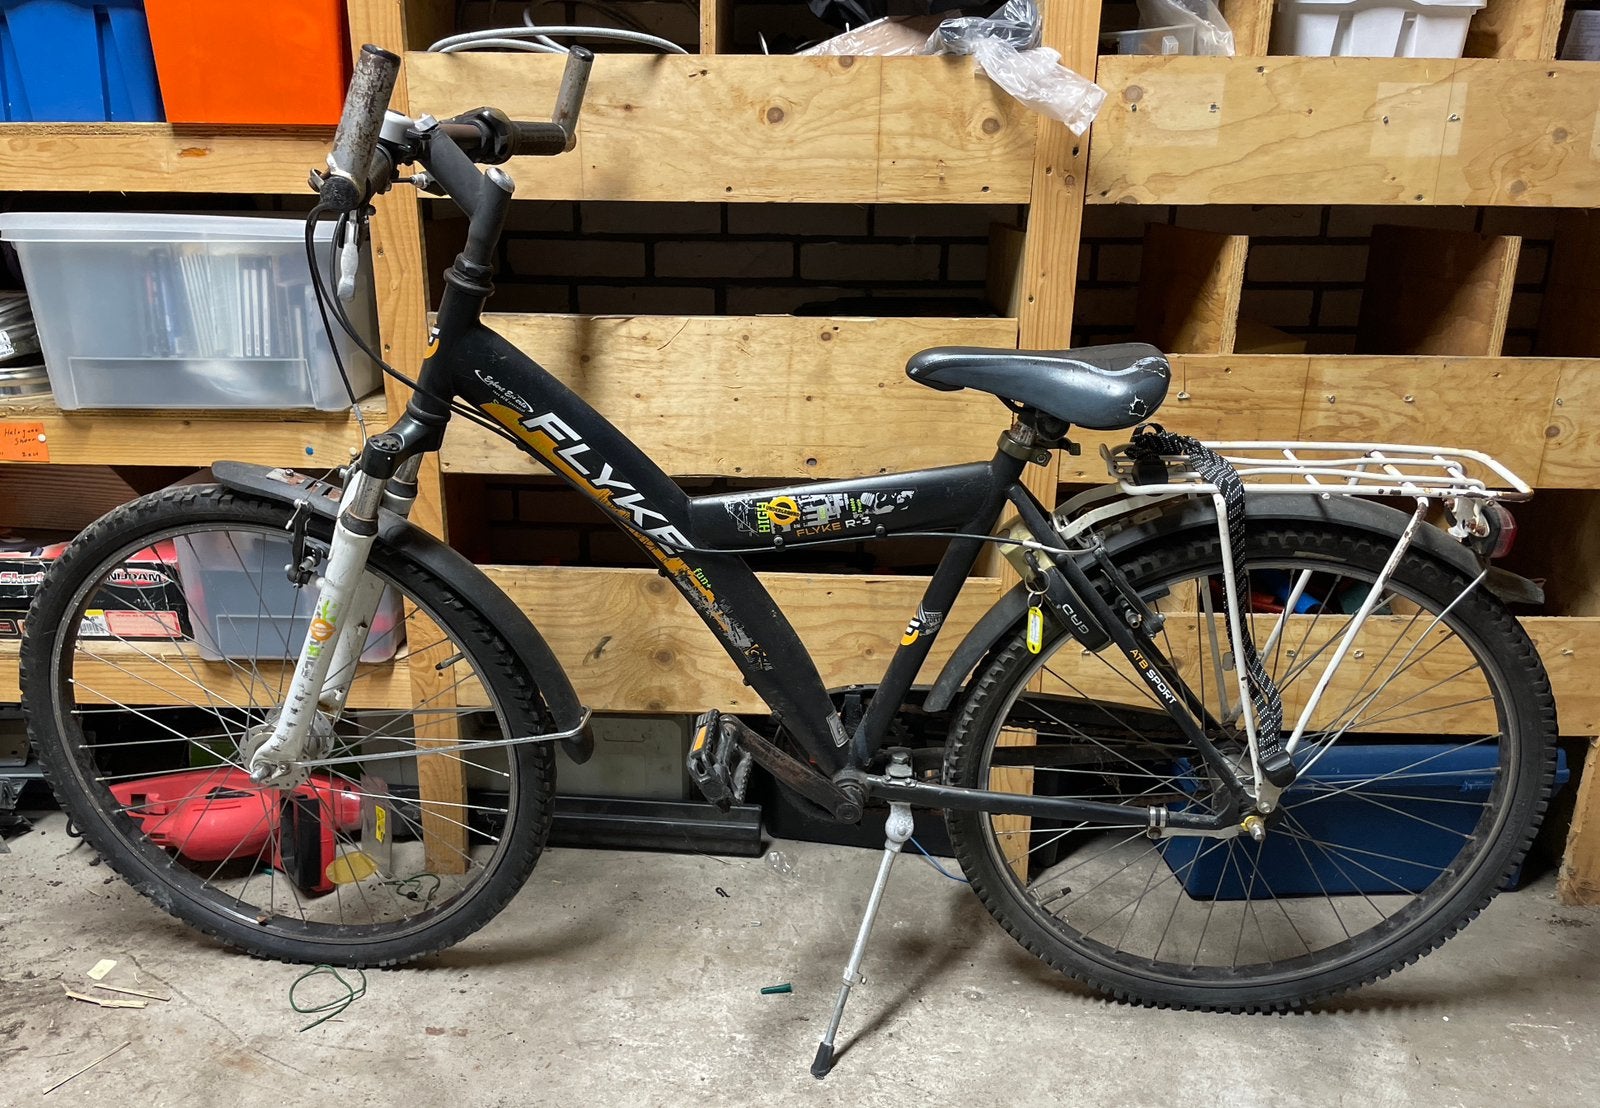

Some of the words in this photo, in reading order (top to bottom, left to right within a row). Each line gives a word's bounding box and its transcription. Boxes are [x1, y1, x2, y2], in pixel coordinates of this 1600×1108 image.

[522, 412, 697, 556] FLYKE
[756, 502, 771, 533] HIGH
[796, 522, 841, 537] FLYKE
[845, 516, 872, 528] R-3
[1130, 649, 1149, 670] ATB
[1146, 669, 1177, 704] SPORT
